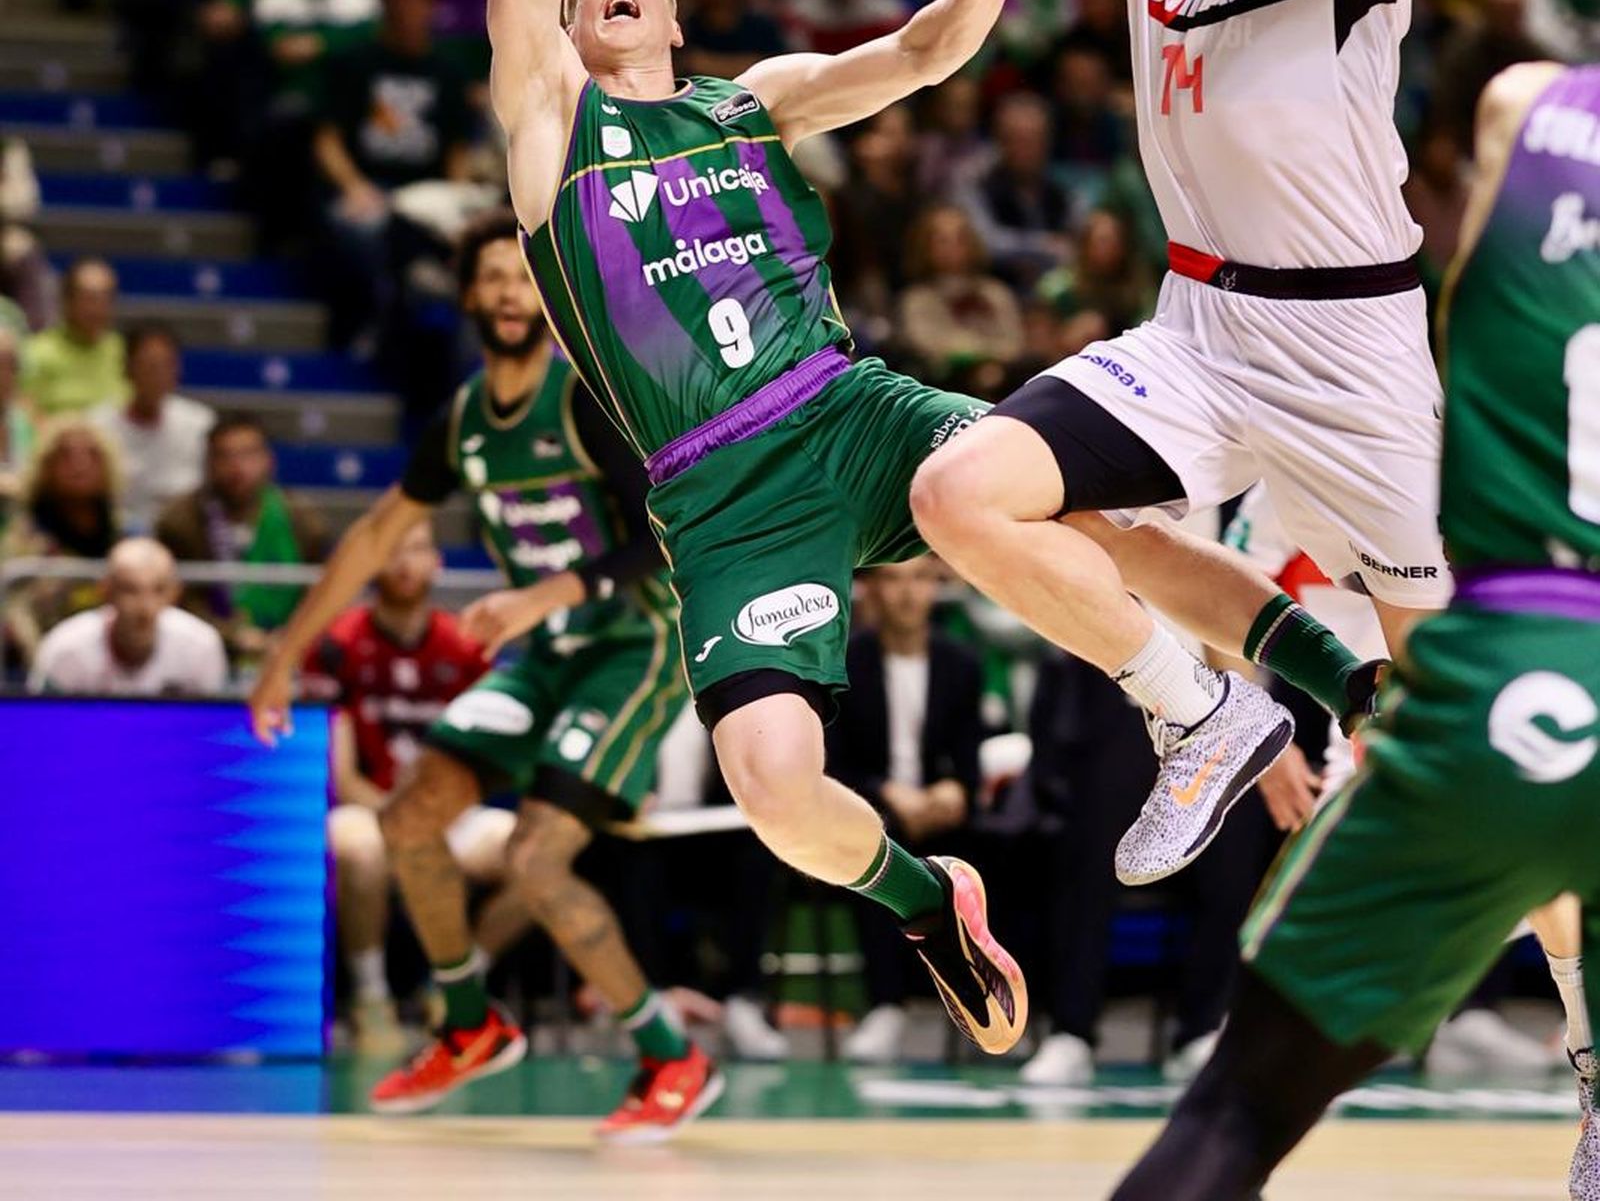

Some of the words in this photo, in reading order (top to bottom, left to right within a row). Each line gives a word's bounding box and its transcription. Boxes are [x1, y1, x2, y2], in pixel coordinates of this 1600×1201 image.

[663, 164, 770, 207] Unicaja
[708, 298, 755, 369] 9
[930, 411, 960, 449] sabor
